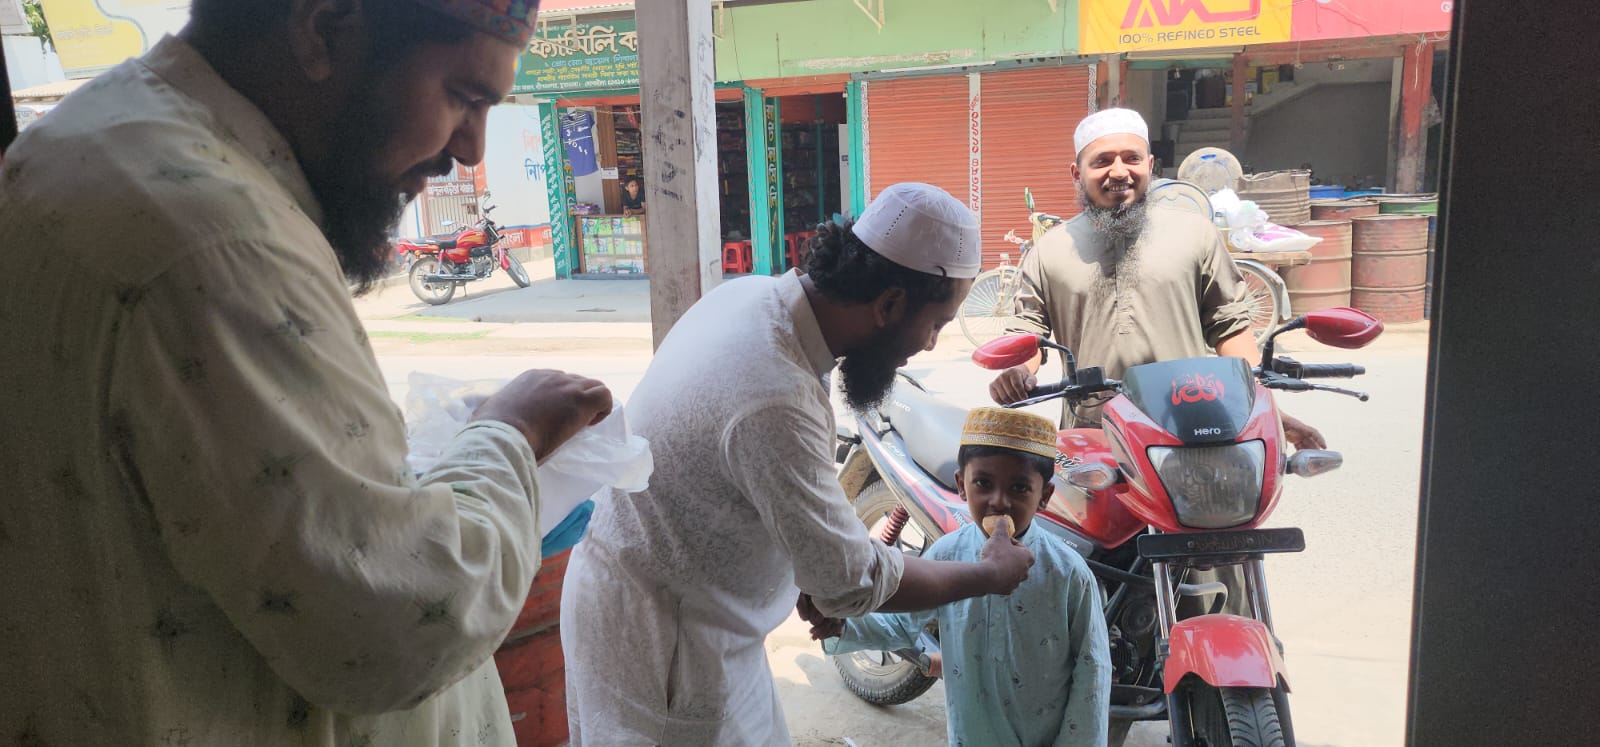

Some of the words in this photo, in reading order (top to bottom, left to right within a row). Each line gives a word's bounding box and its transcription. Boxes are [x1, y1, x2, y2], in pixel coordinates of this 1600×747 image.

[1119, 34, 1153, 44] 100%
[1157, 29, 1215, 42] REFINED
[1219, 26, 1261, 37] STEEL
[1194, 427, 1221, 436] Hero
